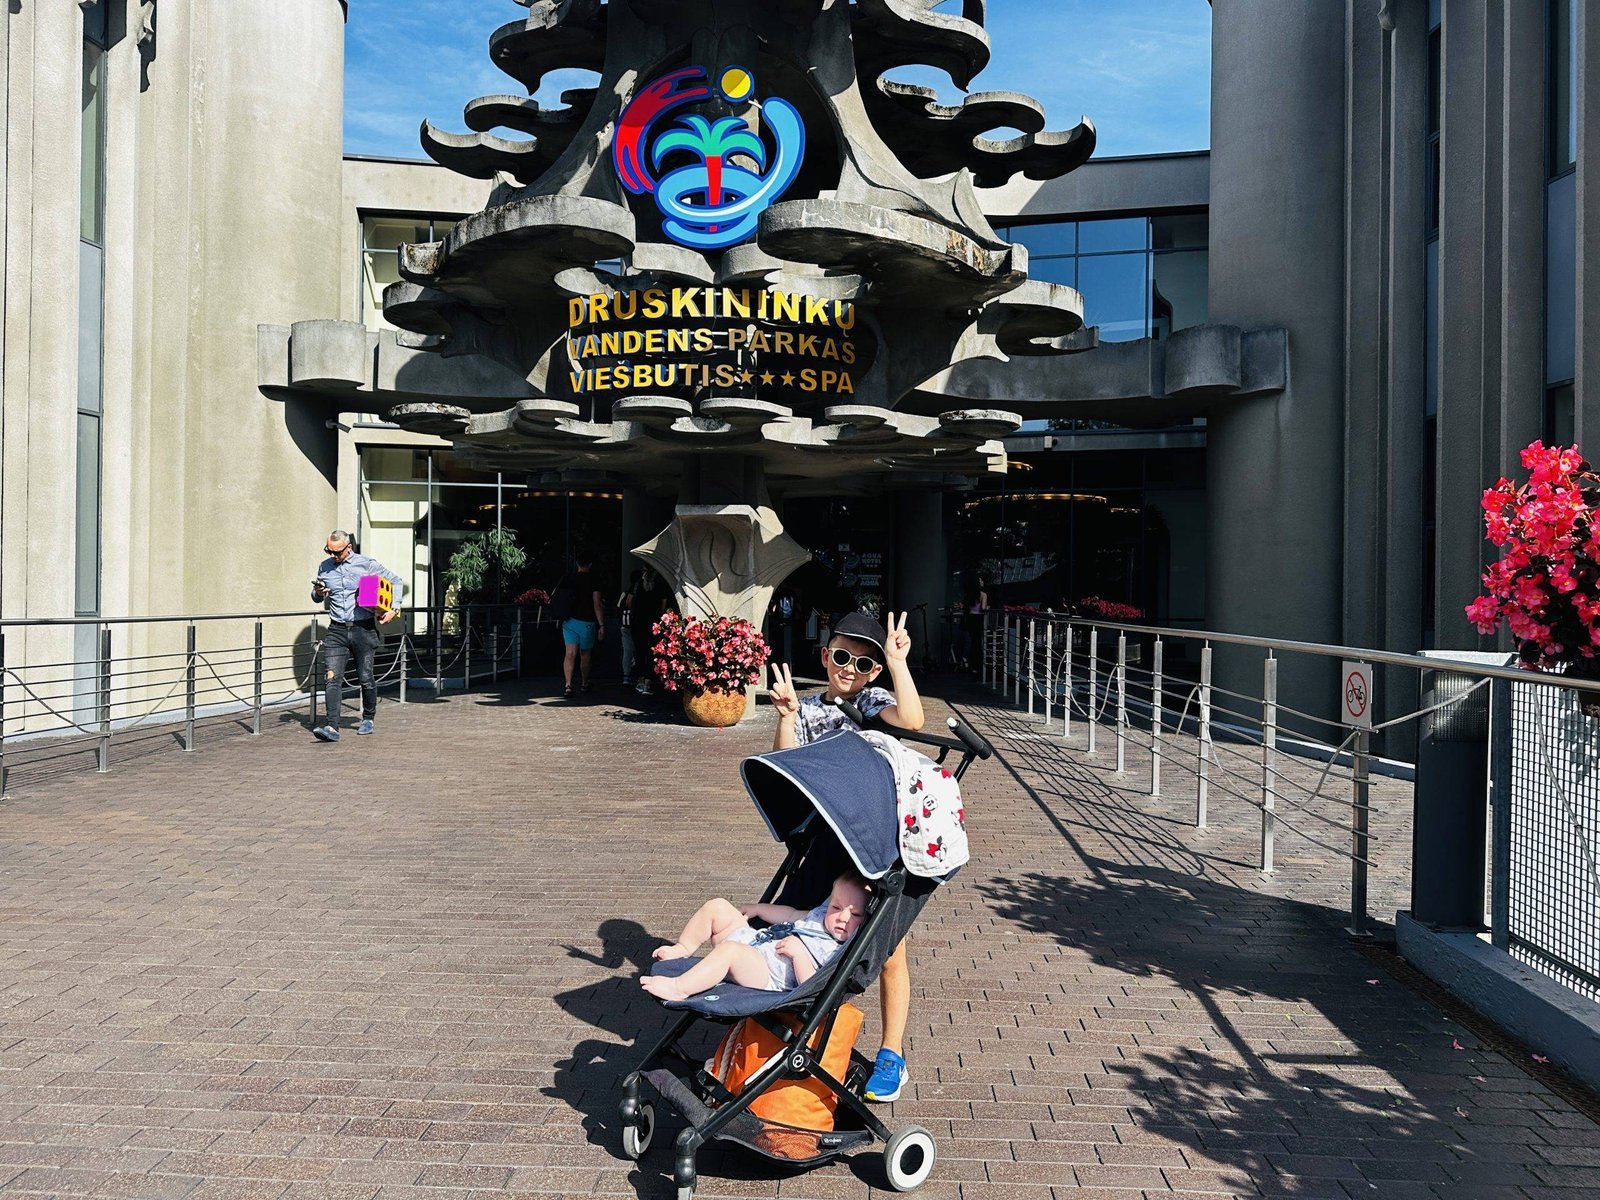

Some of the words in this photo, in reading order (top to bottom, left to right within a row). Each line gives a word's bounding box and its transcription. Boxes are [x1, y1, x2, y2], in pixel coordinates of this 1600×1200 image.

[569, 287, 855, 337] DRUSKININKŲ
[569, 328, 713, 360] VANDENS
[728, 328, 856, 365] PARKAS
[569, 360, 735, 393] VIEŠBUTIS
[799, 367, 855, 394] SPA
